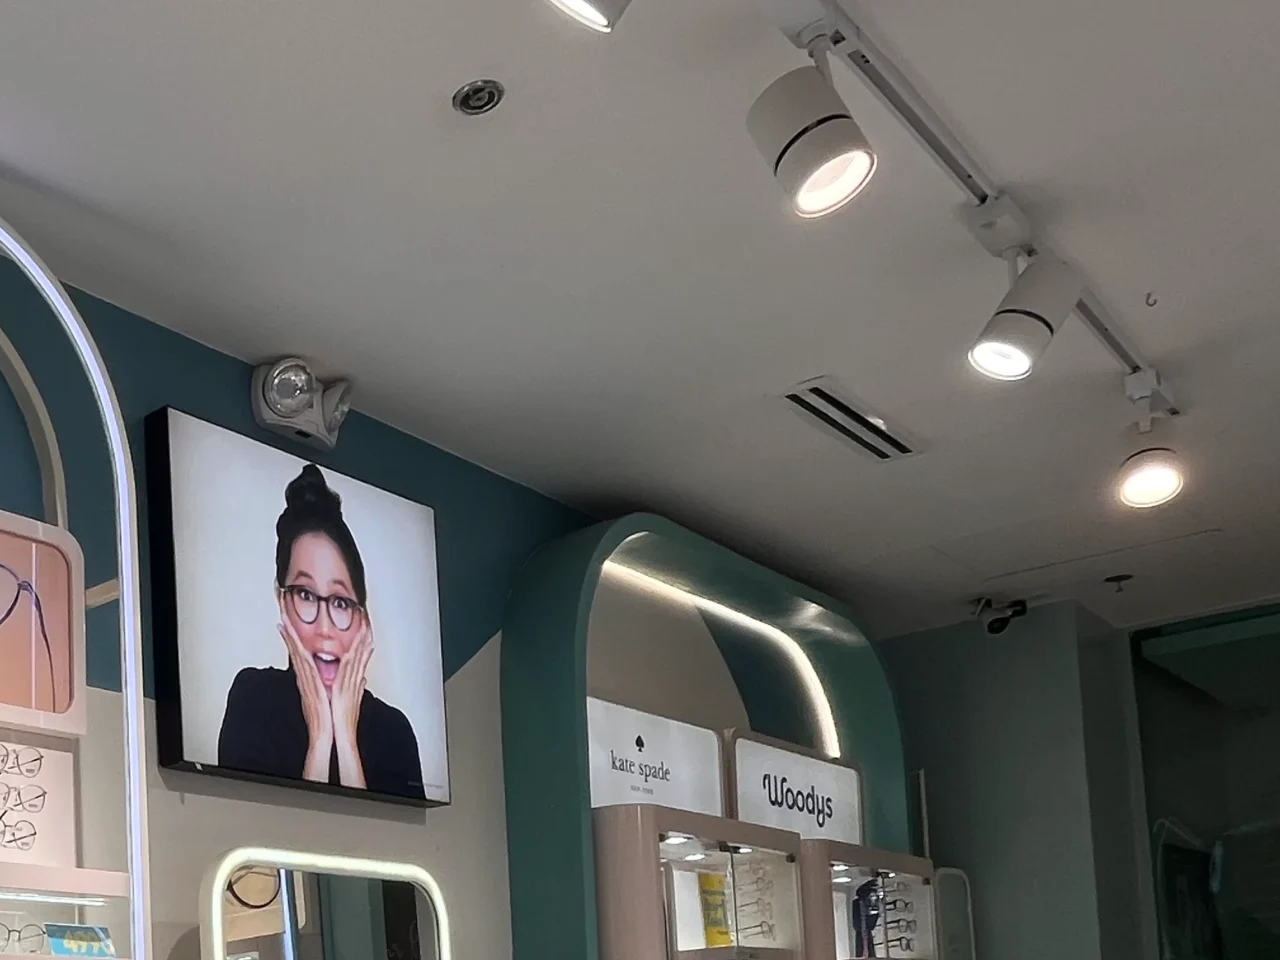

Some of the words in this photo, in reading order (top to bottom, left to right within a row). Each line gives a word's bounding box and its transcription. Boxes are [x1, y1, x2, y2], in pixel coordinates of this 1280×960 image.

[610, 750, 635, 774] kate
[638, 759, 670, 783] spade
[763, 773, 833, 827] Woodys
